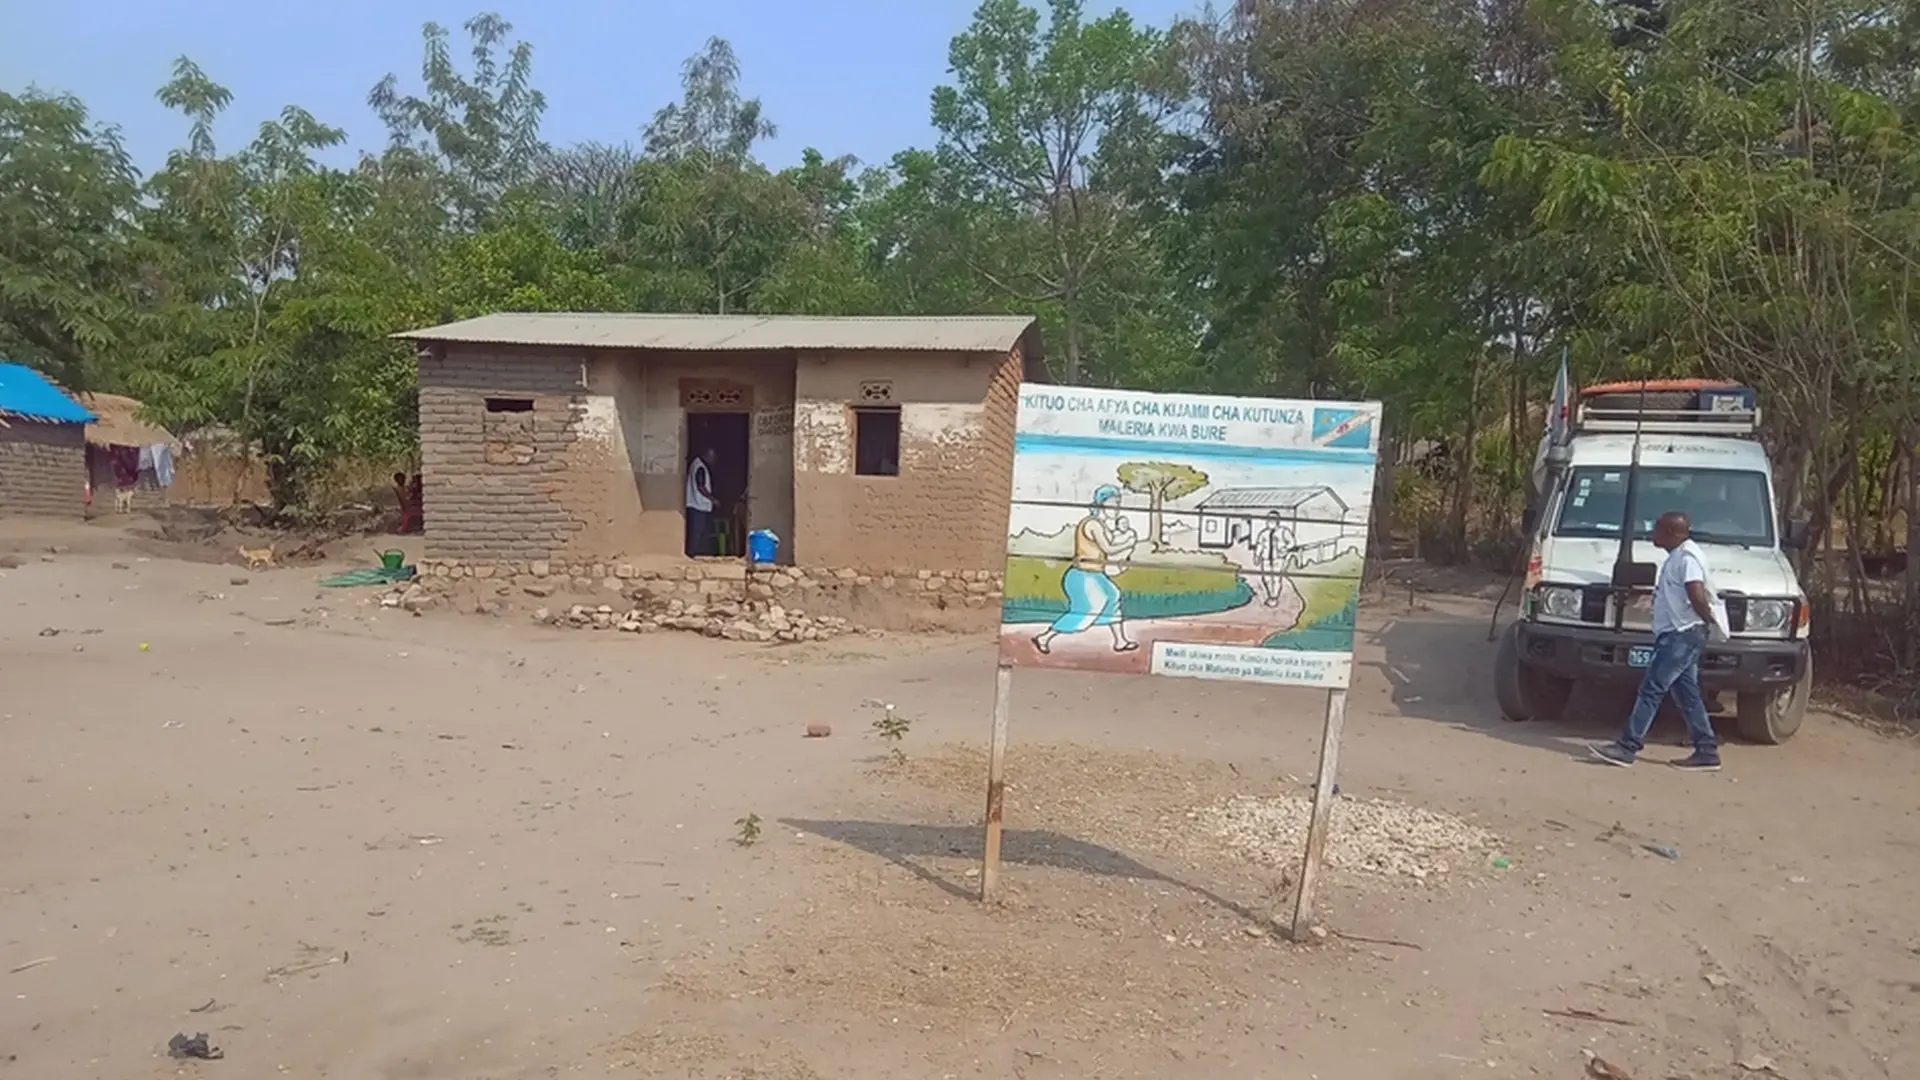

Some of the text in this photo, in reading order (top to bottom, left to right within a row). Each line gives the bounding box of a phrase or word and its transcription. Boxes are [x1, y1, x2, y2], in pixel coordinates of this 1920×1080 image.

[1023, 395, 1065, 410] KITUO
[1067, 397, 1095, 412] CHA
[1096, 399, 1130, 414] AFYA
[1133, 401, 1160, 416] CHA
[1212, 405, 1241, 421] CHA
[1243, 406, 1305, 424] KUTUNZA
[1099, 419, 1227, 441] MALERIA KWA BURE
